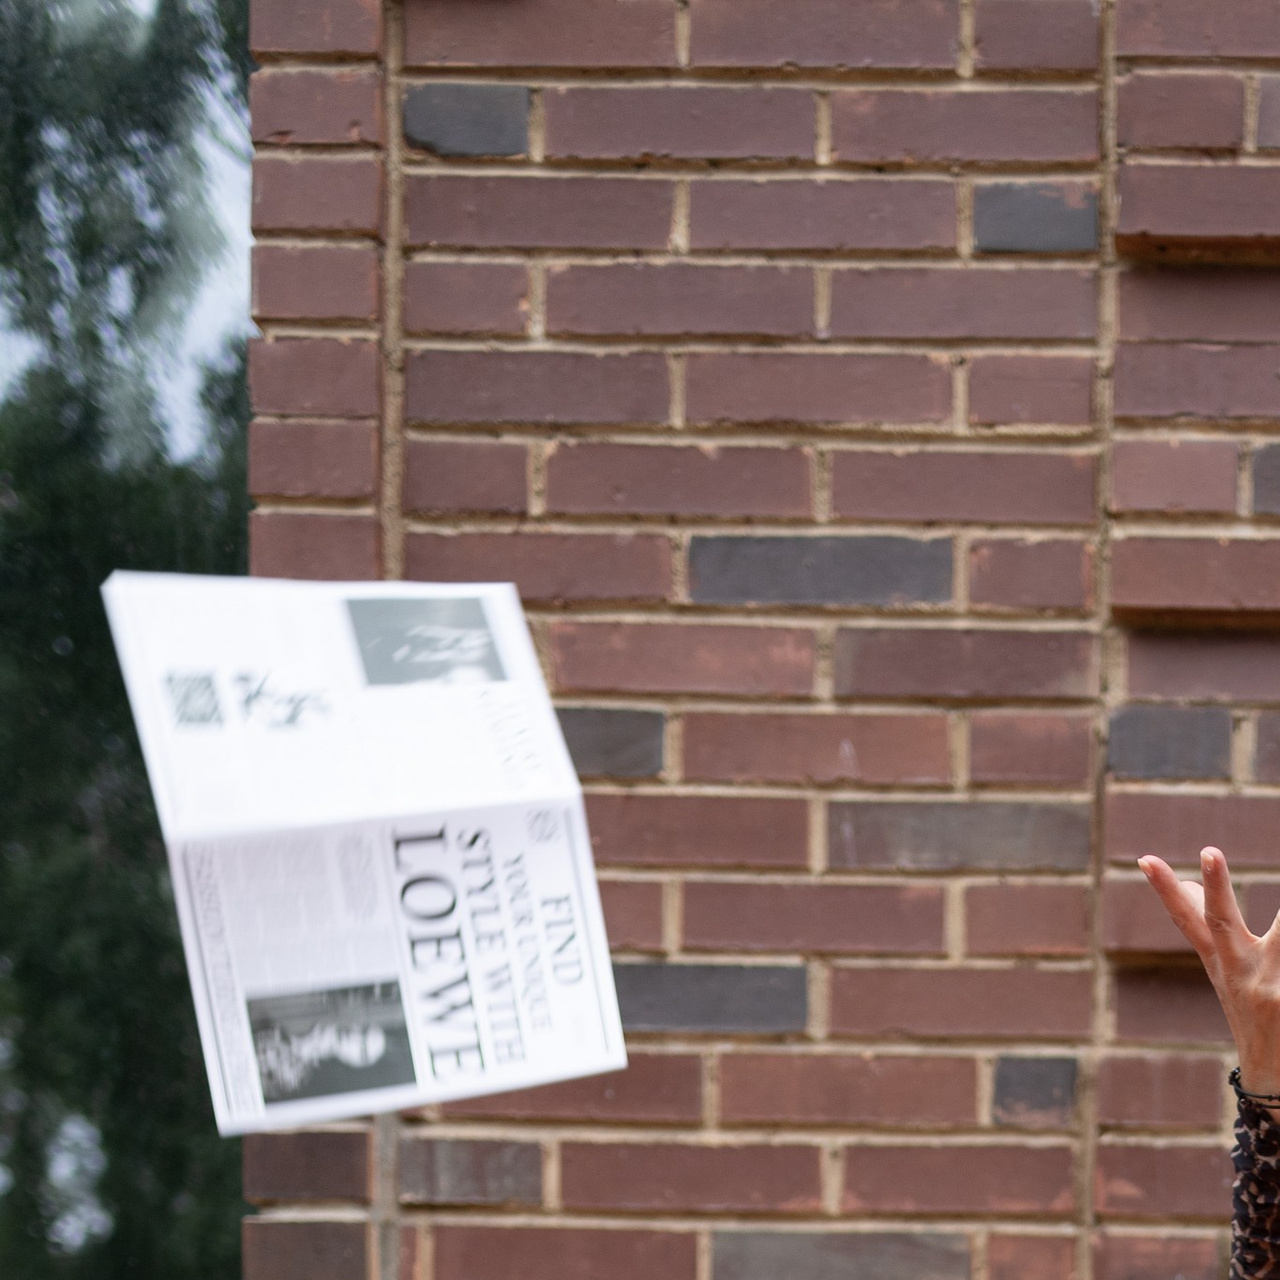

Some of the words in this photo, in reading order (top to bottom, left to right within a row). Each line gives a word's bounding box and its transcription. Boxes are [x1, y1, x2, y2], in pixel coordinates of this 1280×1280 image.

[502, 854, 537, 927] YOUR
[394, 825, 484, 1079] LOEWE
[456, 829, 507, 952] STYLE
[484, 964, 526, 1065] WITH
[517, 934, 553, 1031] UNIQUE
[541, 894, 584, 986] FIND
